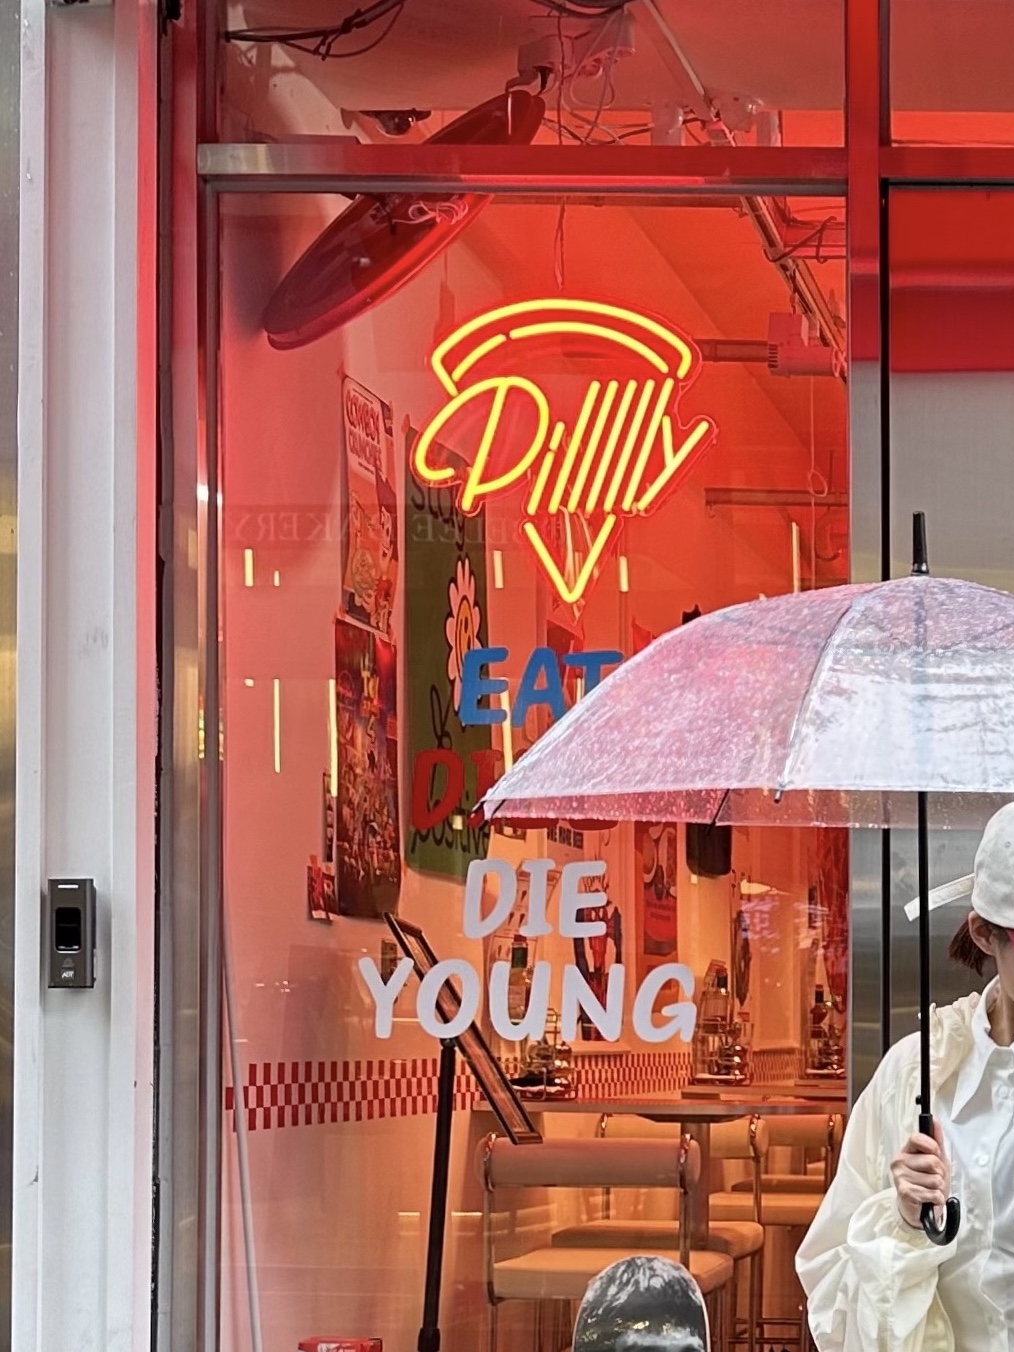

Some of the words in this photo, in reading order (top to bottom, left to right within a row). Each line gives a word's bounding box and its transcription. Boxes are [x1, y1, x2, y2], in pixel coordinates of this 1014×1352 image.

[458, 647, 625, 728] EAT
[463, 858, 608, 939] DIE
[358, 957, 697, 1043] YOUNG
